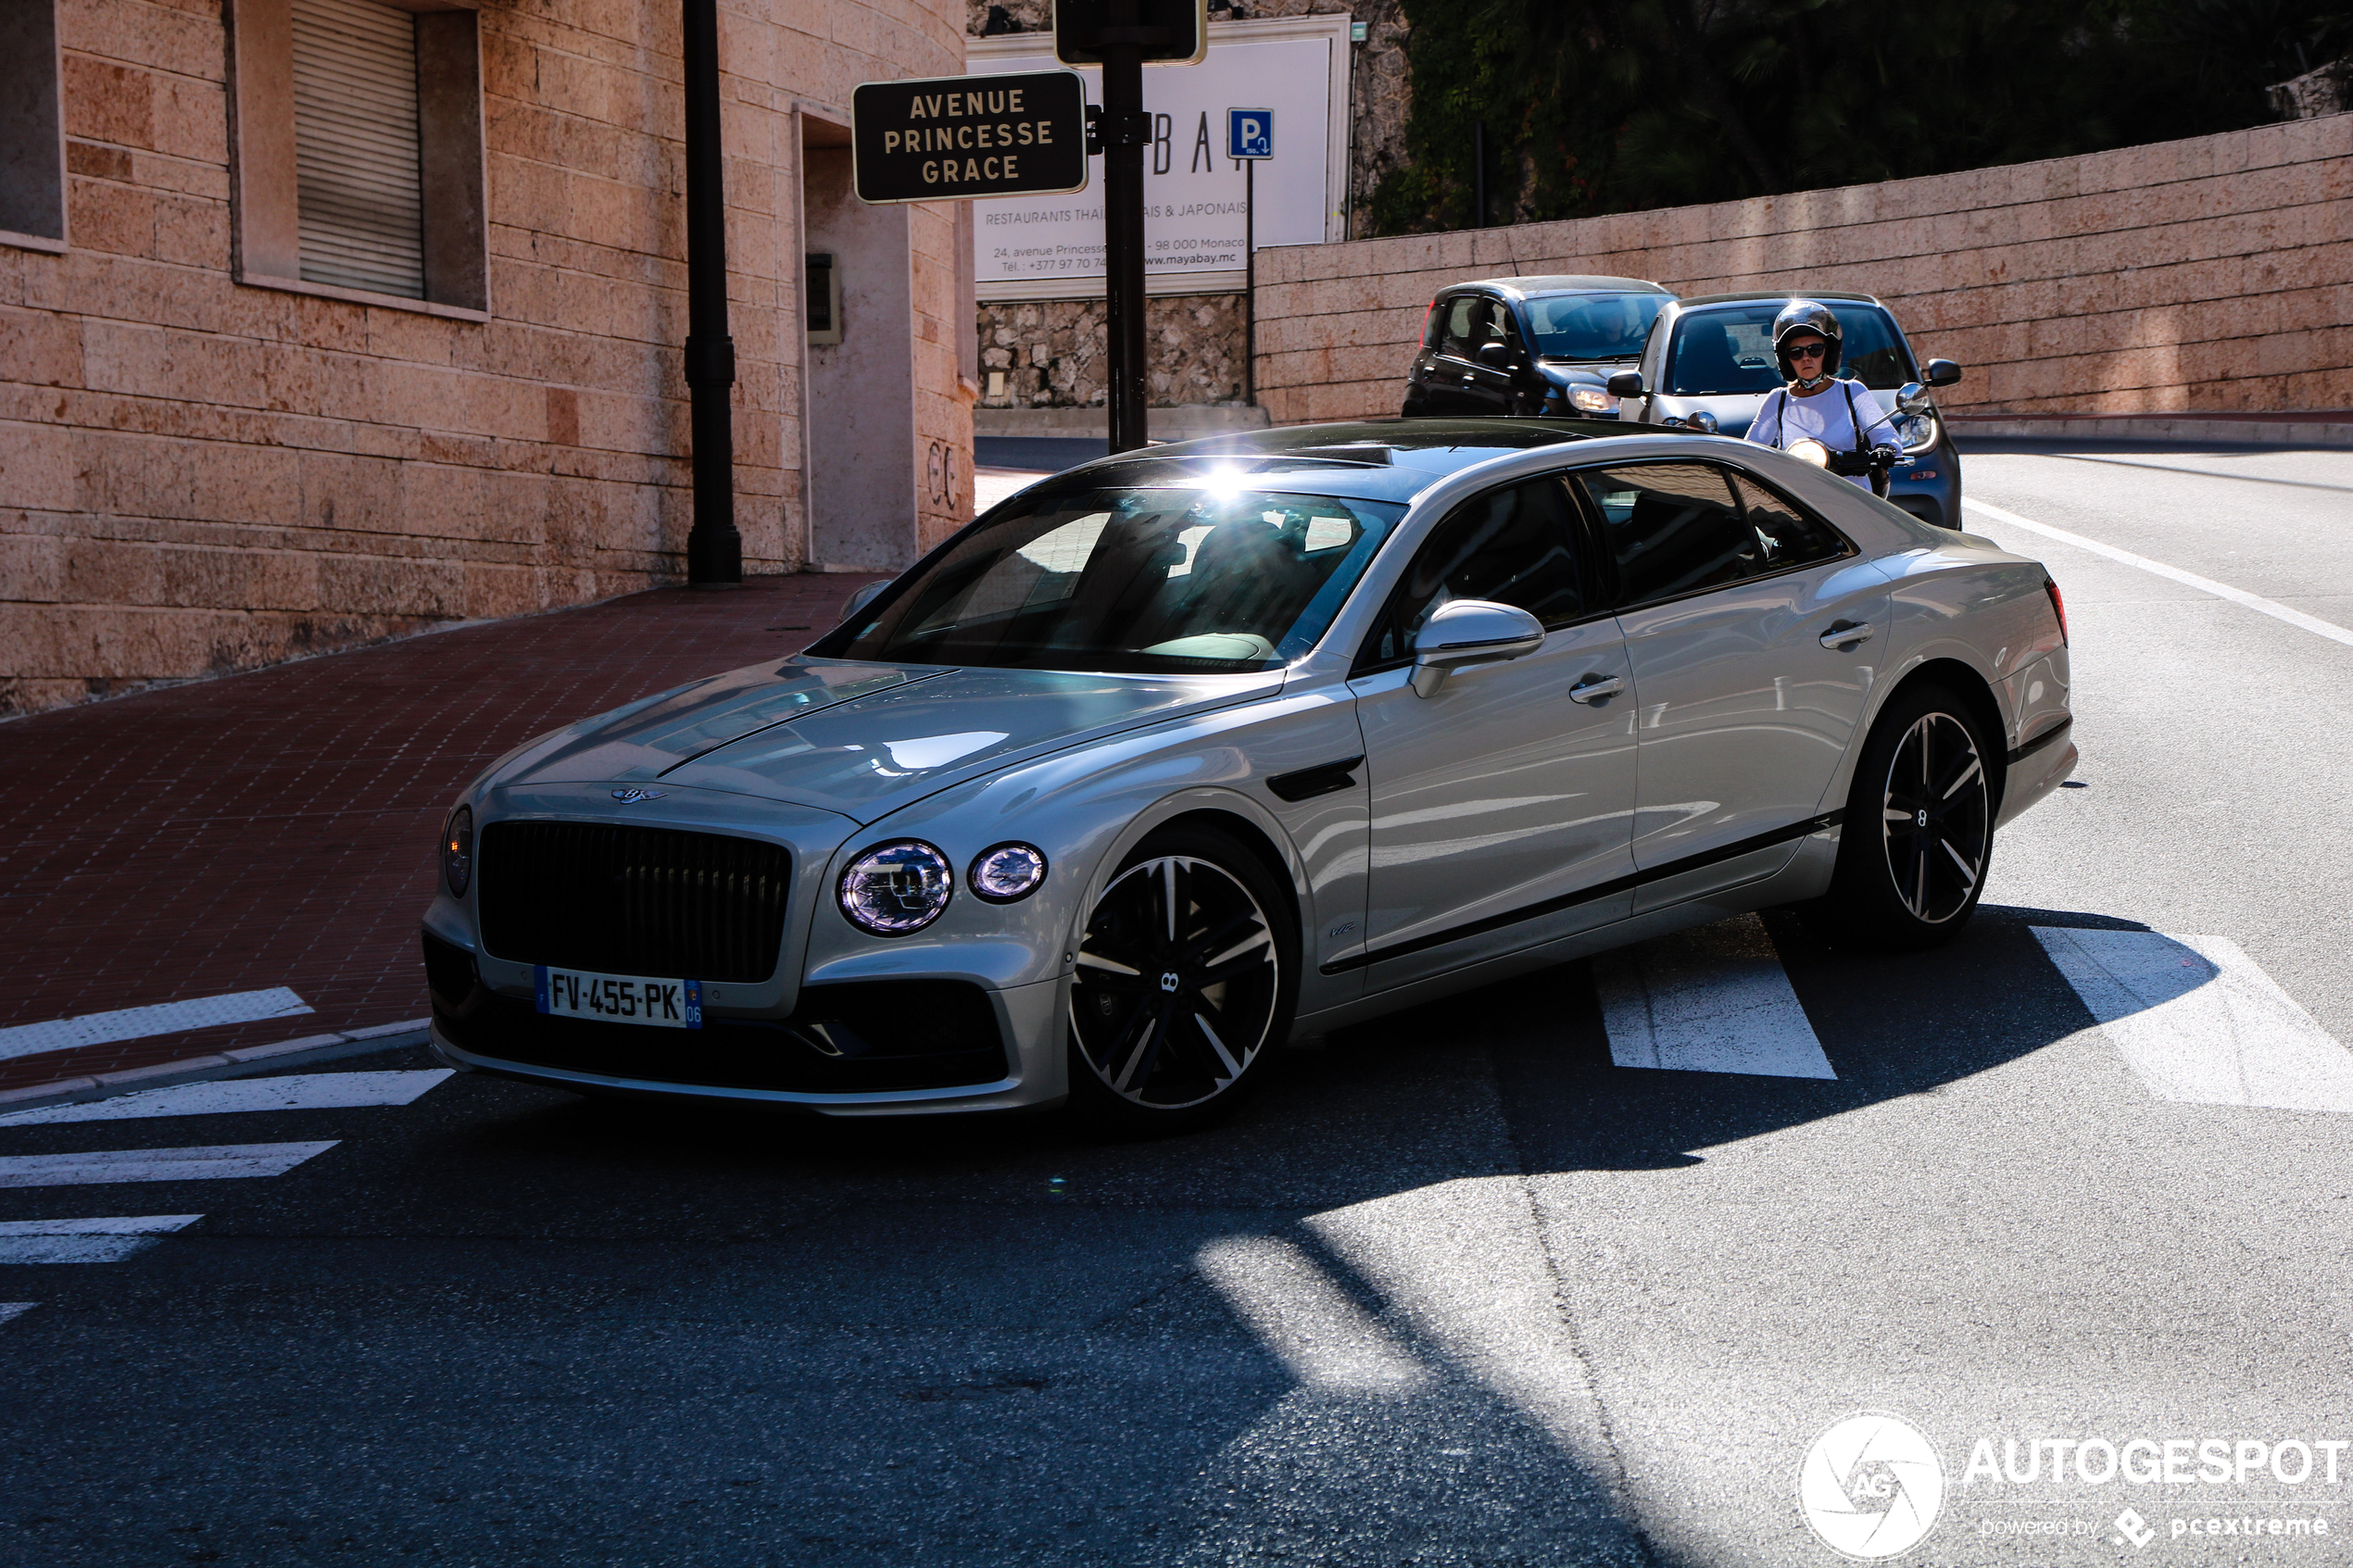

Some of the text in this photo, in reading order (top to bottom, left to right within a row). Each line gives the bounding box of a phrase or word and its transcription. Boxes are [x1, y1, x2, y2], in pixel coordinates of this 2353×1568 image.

[910, 90, 1025, 119] AVENUE
[885, 120, 1053, 154] PRINCESSE
[1153, 110, 1240, 175] BA
[1241, 118, 1261, 148] P
[922, 156, 1019, 183] GRACE
[986, 209, 1072, 225] RESTAURANTS
[1164, 205, 1175, 217] &
[1178, 201, 1247, 217] JAPONAIS
[993, 247, 1011, 258] 24,
[1013, 246, 1052, 257] avenue
[1154, 240, 1170, 251] 98
[1173, 239, 1198, 250] 000
[1201, 238, 1245, 248] Monaco
[1001, 261, 1019, 271] Tél.
[1028, 259, 1055, 270] +377
[1059, 258, 1073, 270] 97
[1076, 258, 1090, 269] 70
[686, 1006, 701, 1023] 06
